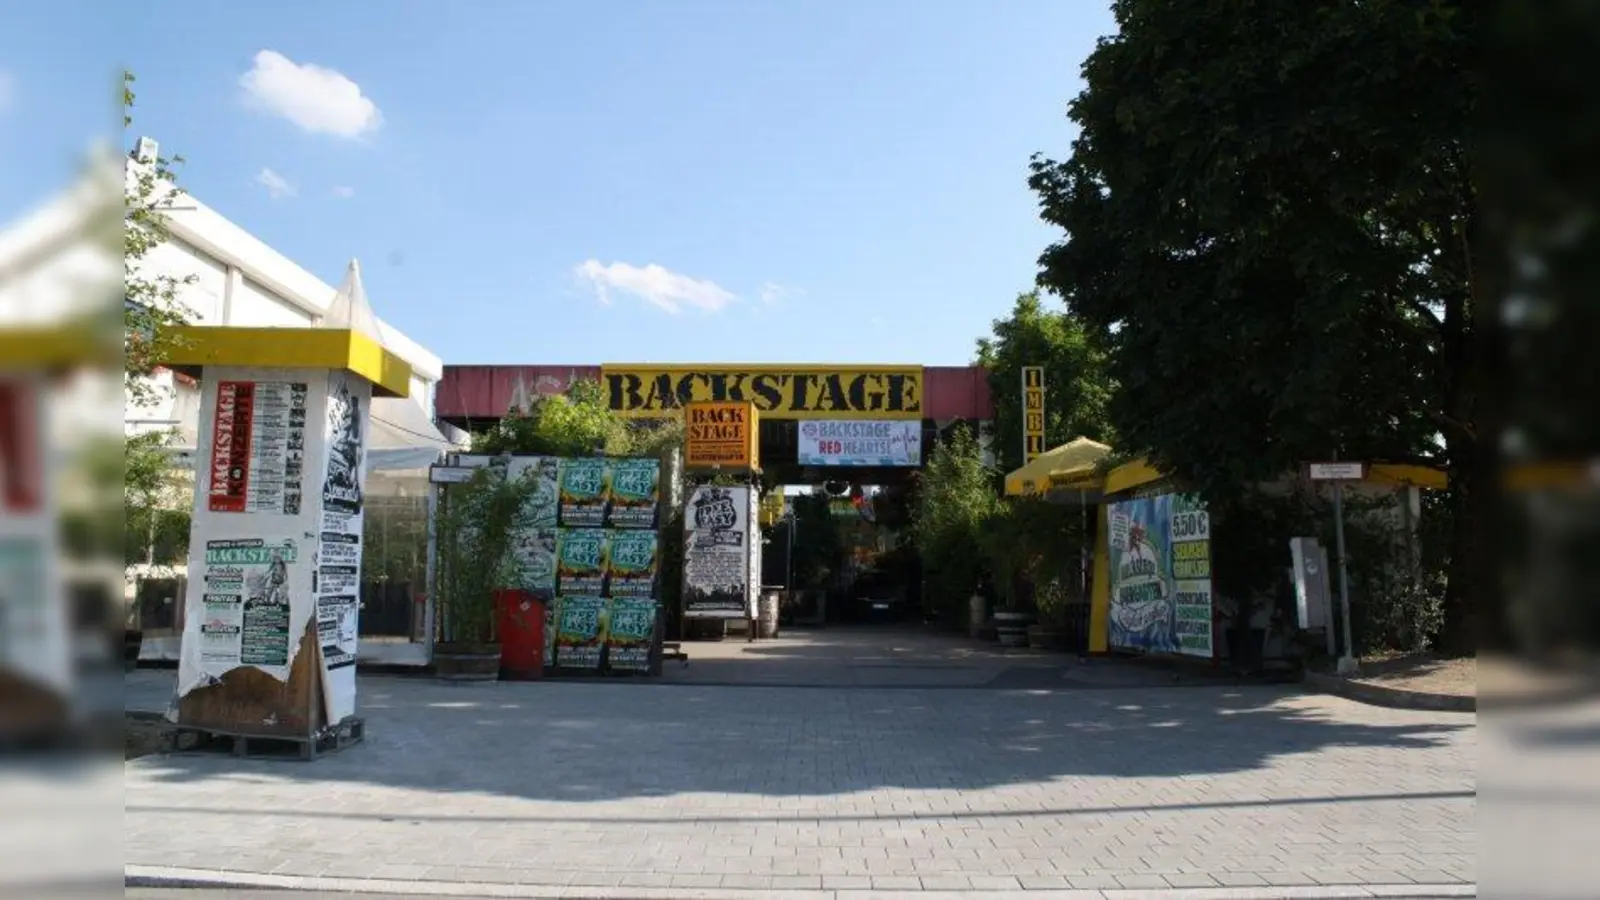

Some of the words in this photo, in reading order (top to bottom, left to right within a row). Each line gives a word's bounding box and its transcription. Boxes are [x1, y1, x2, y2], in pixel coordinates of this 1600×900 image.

[605, 371, 920, 412] BACKSTAGE
[692, 407, 744, 423] BACK
[1026, 370, 1042, 457] IMBI
[691, 424, 744, 440] STAGE
[819, 422, 891, 437] BACKSTAGE
[211, 384, 236, 496] BACKSTAGE
[818, 439, 842, 455] RED
[844, 439, 891, 455] HEARTS!
